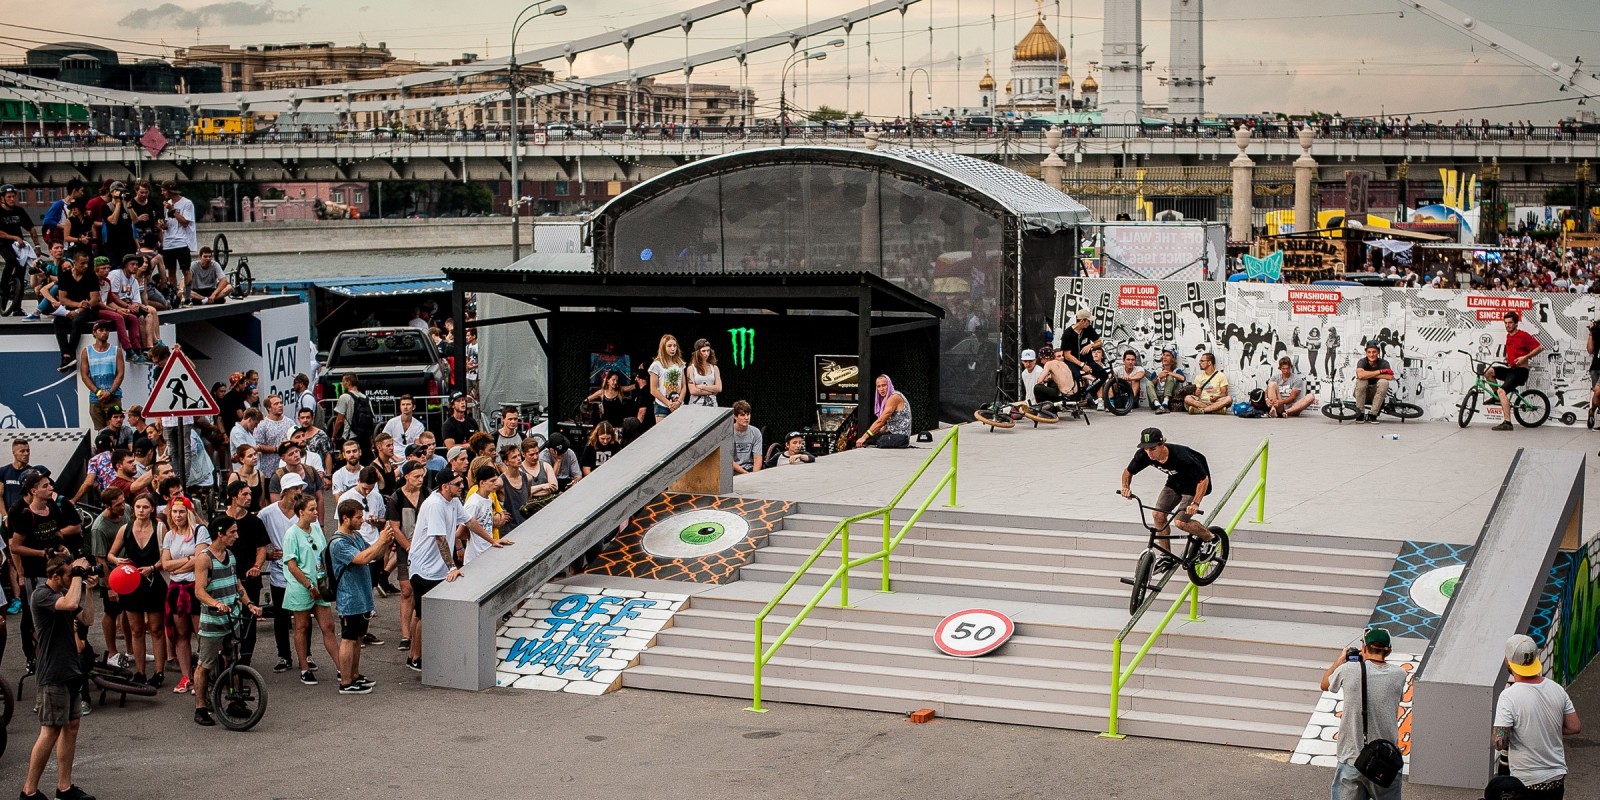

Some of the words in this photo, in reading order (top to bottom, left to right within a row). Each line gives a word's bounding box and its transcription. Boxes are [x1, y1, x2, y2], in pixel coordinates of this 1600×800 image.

[1283, 254, 1323, 268] WEAR
[1122, 286, 1136, 294] OUT
[1137, 287, 1155, 295] LOUD
[1290, 291, 1339, 301] UNFASHIONED
[1120, 298, 1140, 306] SINCE
[1140, 299, 1157, 307] 1966
[1469, 297, 1500, 307] LEAVING
[1501, 299, 1507, 307] A
[1508, 299, 1530, 308] MARK
[1295, 304, 1316, 312] SINCE
[1317, 304, 1335, 313] 1966
[1479, 311, 1500, 319] SINCE
[1486, 407, 1503, 415] VANS
[550, 594, 657, 625] OFF
[544, 617, 627, 652] THE
[950, 621, 996, 642] 50
[504, 636, 604, 678] WALL
